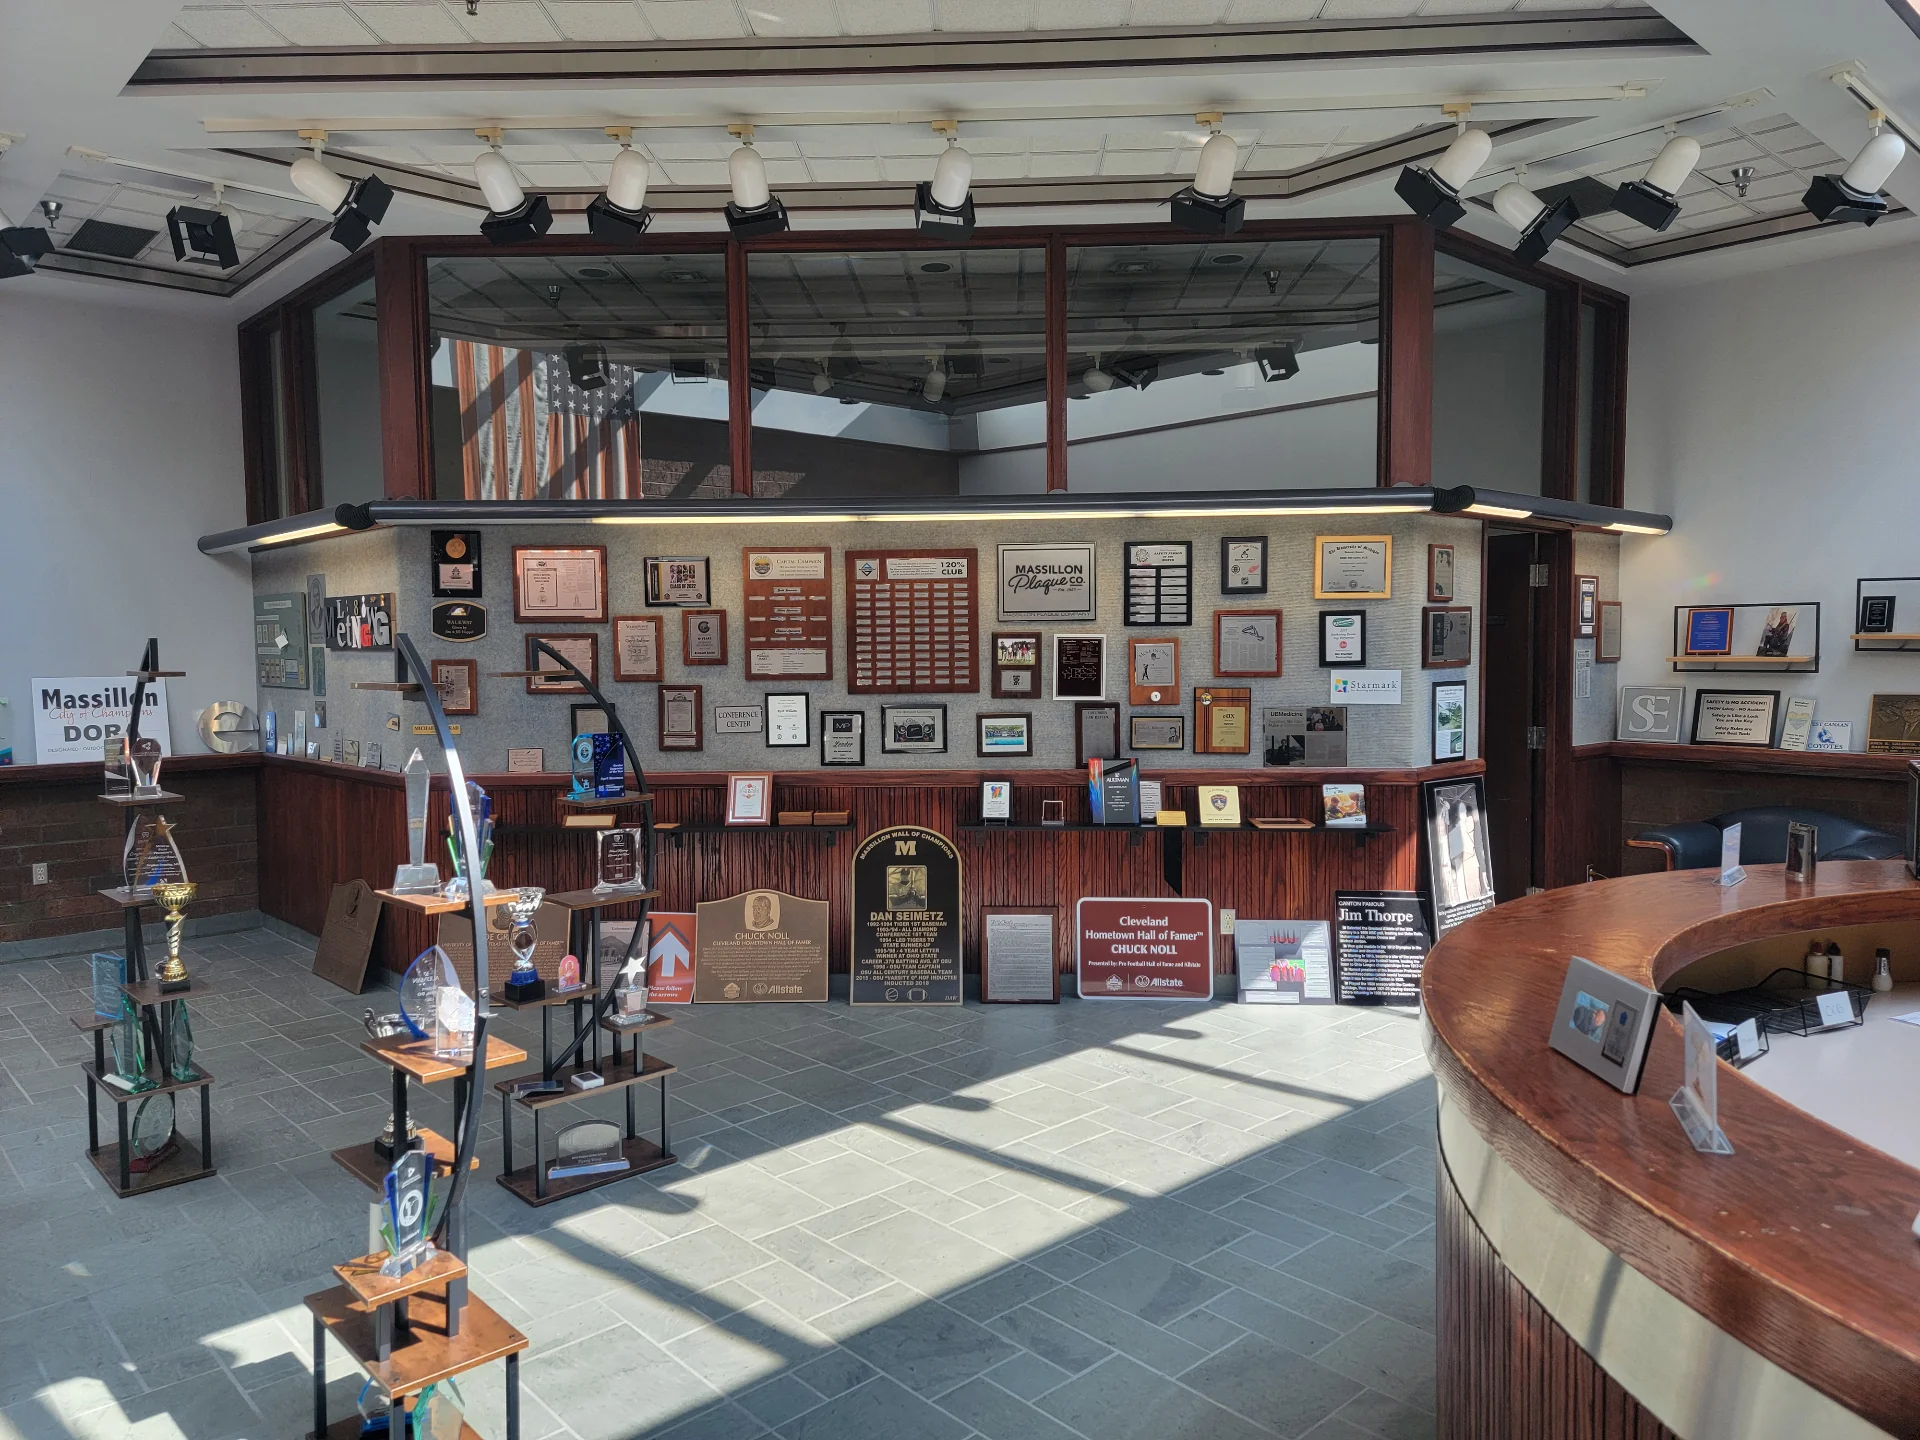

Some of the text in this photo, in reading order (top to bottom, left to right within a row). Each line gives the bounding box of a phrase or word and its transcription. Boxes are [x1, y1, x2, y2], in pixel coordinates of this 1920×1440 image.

[1015, 564, 1083, 574] MASSILLON
[1008, 574, 1086, 595] Plaque CO.
[1350, 680, 1398, 689] Starmark
[48, 706, 76, 725] City
[91, 706, 153, 722] Champns
[718, 710, 759, 719] CONFERENCE
[726, 720, 751, 728] CENTER
[1807, 742, 1844, 750] COYOTES
[859, 833, 891, 860] MASSILLON
[921, 833, 954, 859] CHAMPIONS
[894, 840, 917, 856] M
[870, 911, 944, 921] DAN SEIMETZ
[1119, 916, 1169, 926] Cleveland
[1338, 908, 1414, 926] Jim Thorpe
[734, 932, 790, 940] CHUCK NOLL
[1085, 930, 1135, 940] Hometown
[1137, 930, 1156, 940] Hall
[1158, 930, 1169, 940] of
[1110, 944, 1178, 955] CHUCK NOLL
[1150, 977, 1184, 987] Allstate
[767, 984, 804, 994] Allstate
